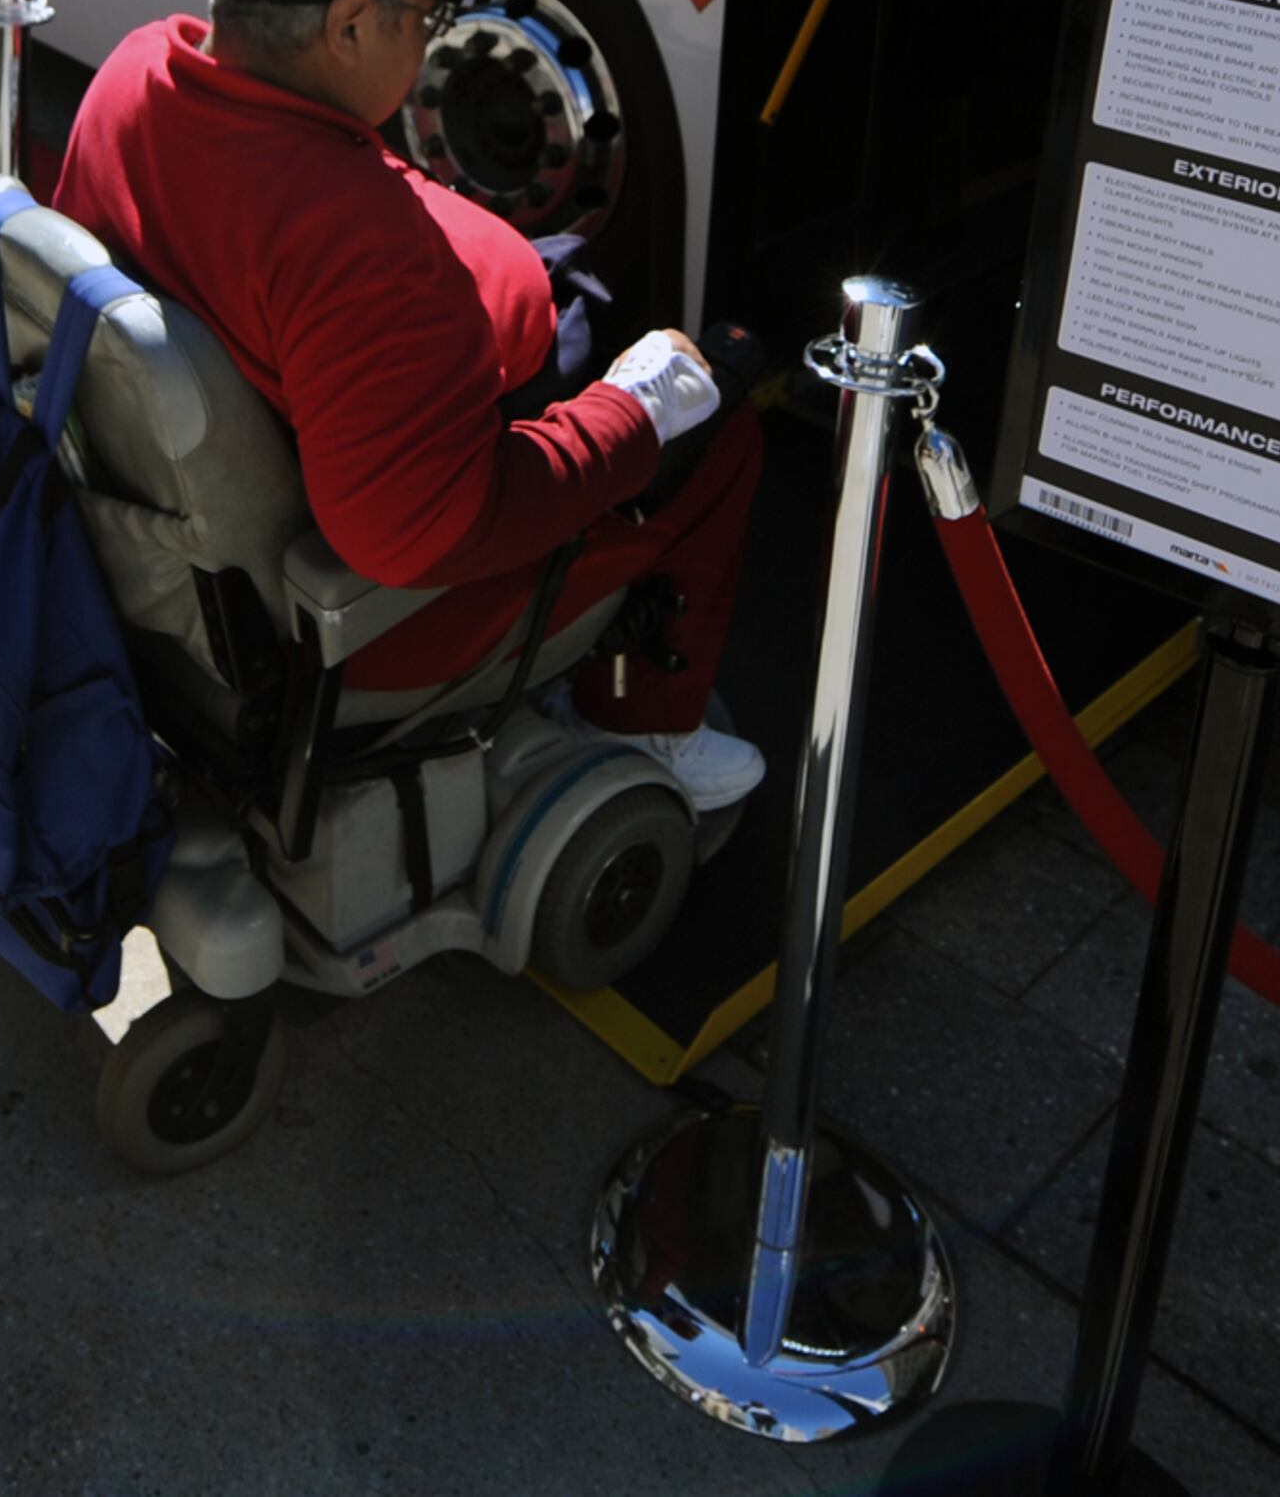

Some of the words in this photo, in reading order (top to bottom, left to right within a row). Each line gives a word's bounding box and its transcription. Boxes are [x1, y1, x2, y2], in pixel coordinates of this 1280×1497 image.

[1134, 3, 1152, 13] TILT
[1153, 7, 1174, 18] AND
[1175, 12, 1233, 31] TELESCOPIC
[1206, 2, 1236, 14] SEATS
[1237, 8, 1263, 20] WITH
[1264, 14, 1271, 22] 2
[1131, 19, 1165, 33] LARGER
[1166, 27, 1205, 41] WINDOW
[1206, 35, 1253, 52] OPENINGS
[1128, 34, 1162, 48] POWER
[1163, 42, 1221, 61] ADJUSTABLE
[1222, 55, 1256, 69] BRAKE
[1257, 63, 1279, 74] AND
[1121, 76, 1165, 93] SECURITY
[1166, 87, 1212, 104] CAMERAS
[1124, 60, 1175, 79] AUTOMATIC
[1176, 73, 1217, 88] CLIMATE
[1217, 82, 1271, 101] CONTROLS
[1191, 65, 1208, 75] ALL
[1209, 69, 1257, 87] ELECTRIC
[1258, 81, 1276, 91] AIR
[1114, 117, 1133, 128] LCD
[1134, 122, 1170, 137] SCREEN
[1116, 106, 1134, 117] LED
[1135, 111, 1193, 132] INSTRUMENT
[1194, 126, 1225, 140] PANEL
[1226, 134, 1252, 147] WITH
[1119, 92, 1170, 110] INCREASED
[1171, 104, 1226, 124] HEADROOM
[1227, 118, 1241, 128] TO
[1242, 122, 1261, 133] THE
